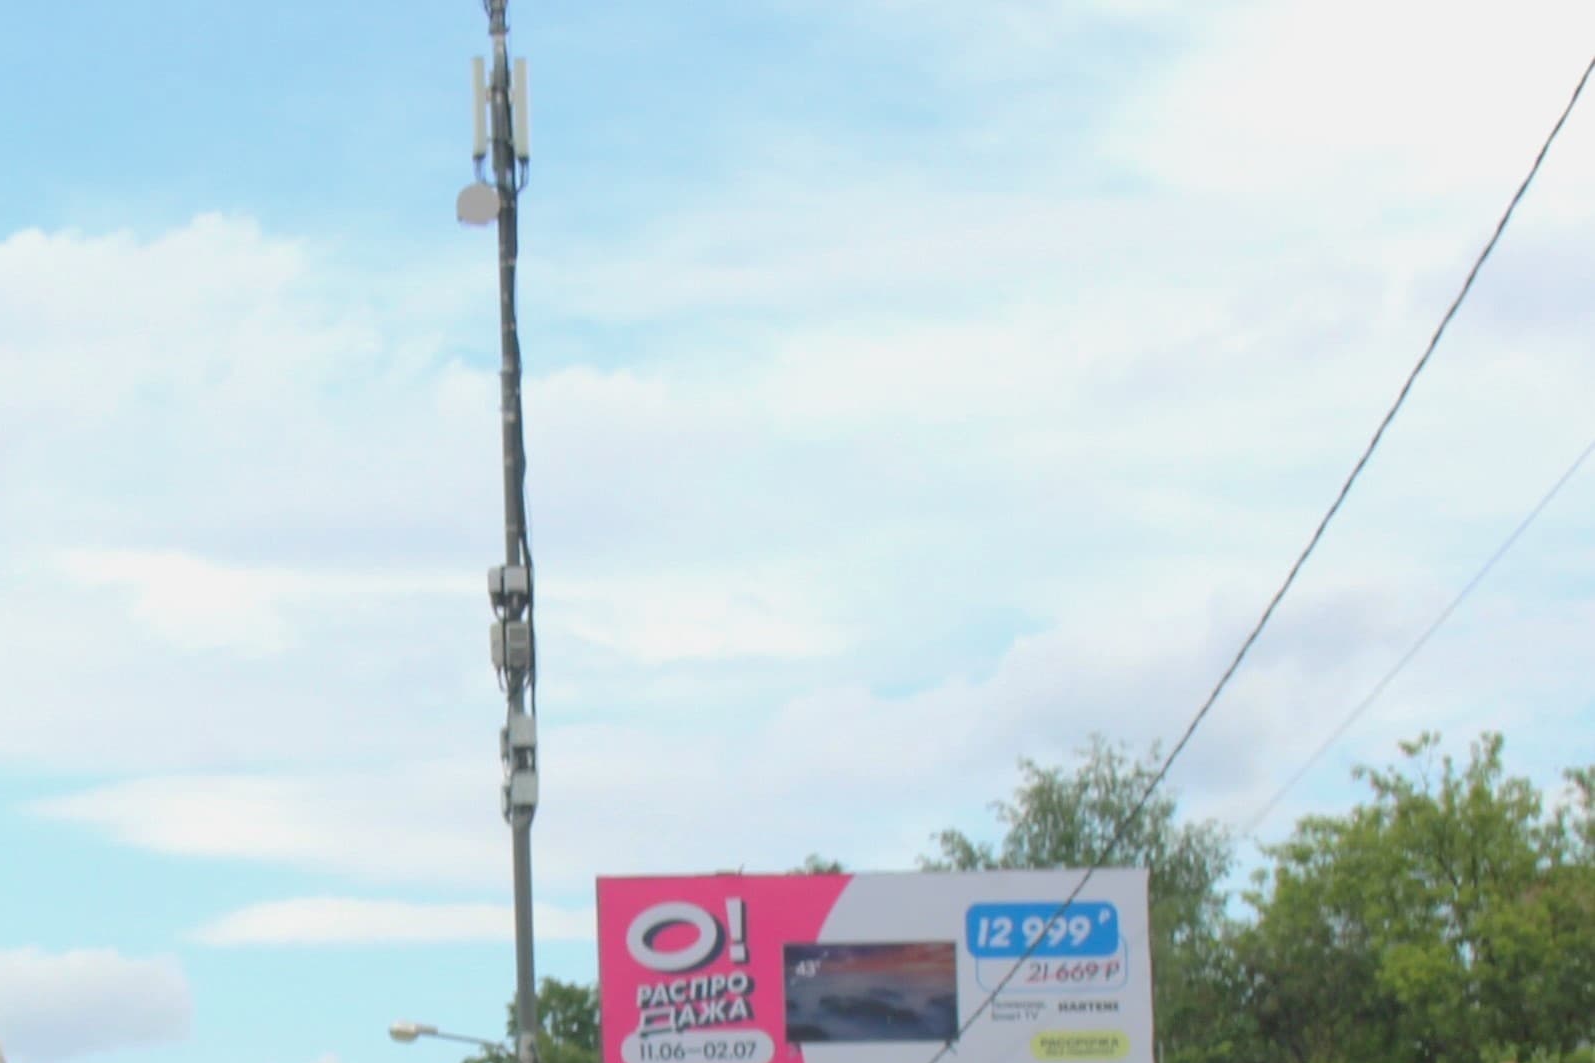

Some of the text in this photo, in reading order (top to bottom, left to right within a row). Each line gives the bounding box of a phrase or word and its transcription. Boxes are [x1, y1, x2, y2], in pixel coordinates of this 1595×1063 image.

[977, 916, 1013, 948] 12
[1021, 915, 1091, 948] 999
[1027, 962, 1049, 983] 21
[1056, 961, 1099, 983] 669
[637, 971, 754, 1009] РАСПРО
[637, 996, 753, 1037] ДАЖА
